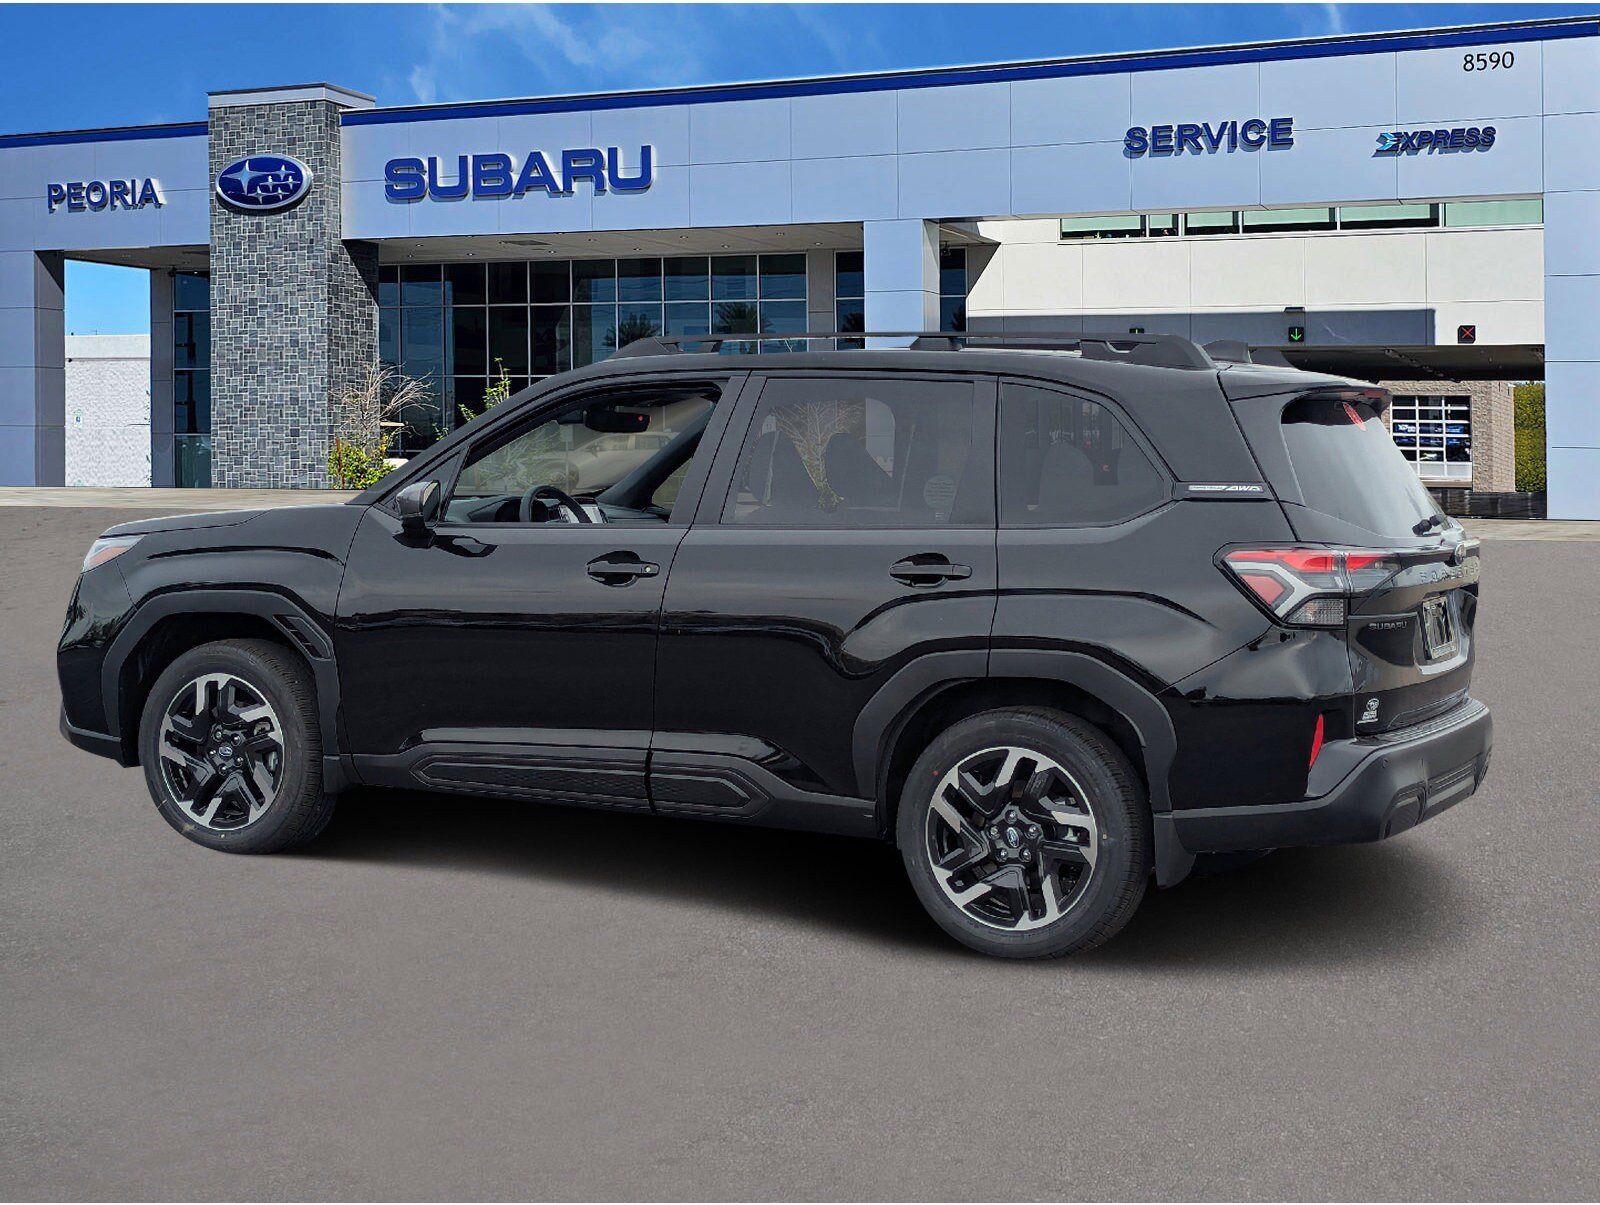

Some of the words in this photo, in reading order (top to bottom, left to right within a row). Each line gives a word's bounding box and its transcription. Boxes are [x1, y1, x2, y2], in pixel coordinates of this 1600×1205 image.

[1463, 51, 1515, 72] 8590
[1125, 117, 1294, 152] SERVICE
[1376, 126, 1497, 152] EXPRESS
[384, 145, 652, 200] SUBARU
[47, 178, 162, 211] PEORIA
[1369, 620, 1407, 630] SUBARU
